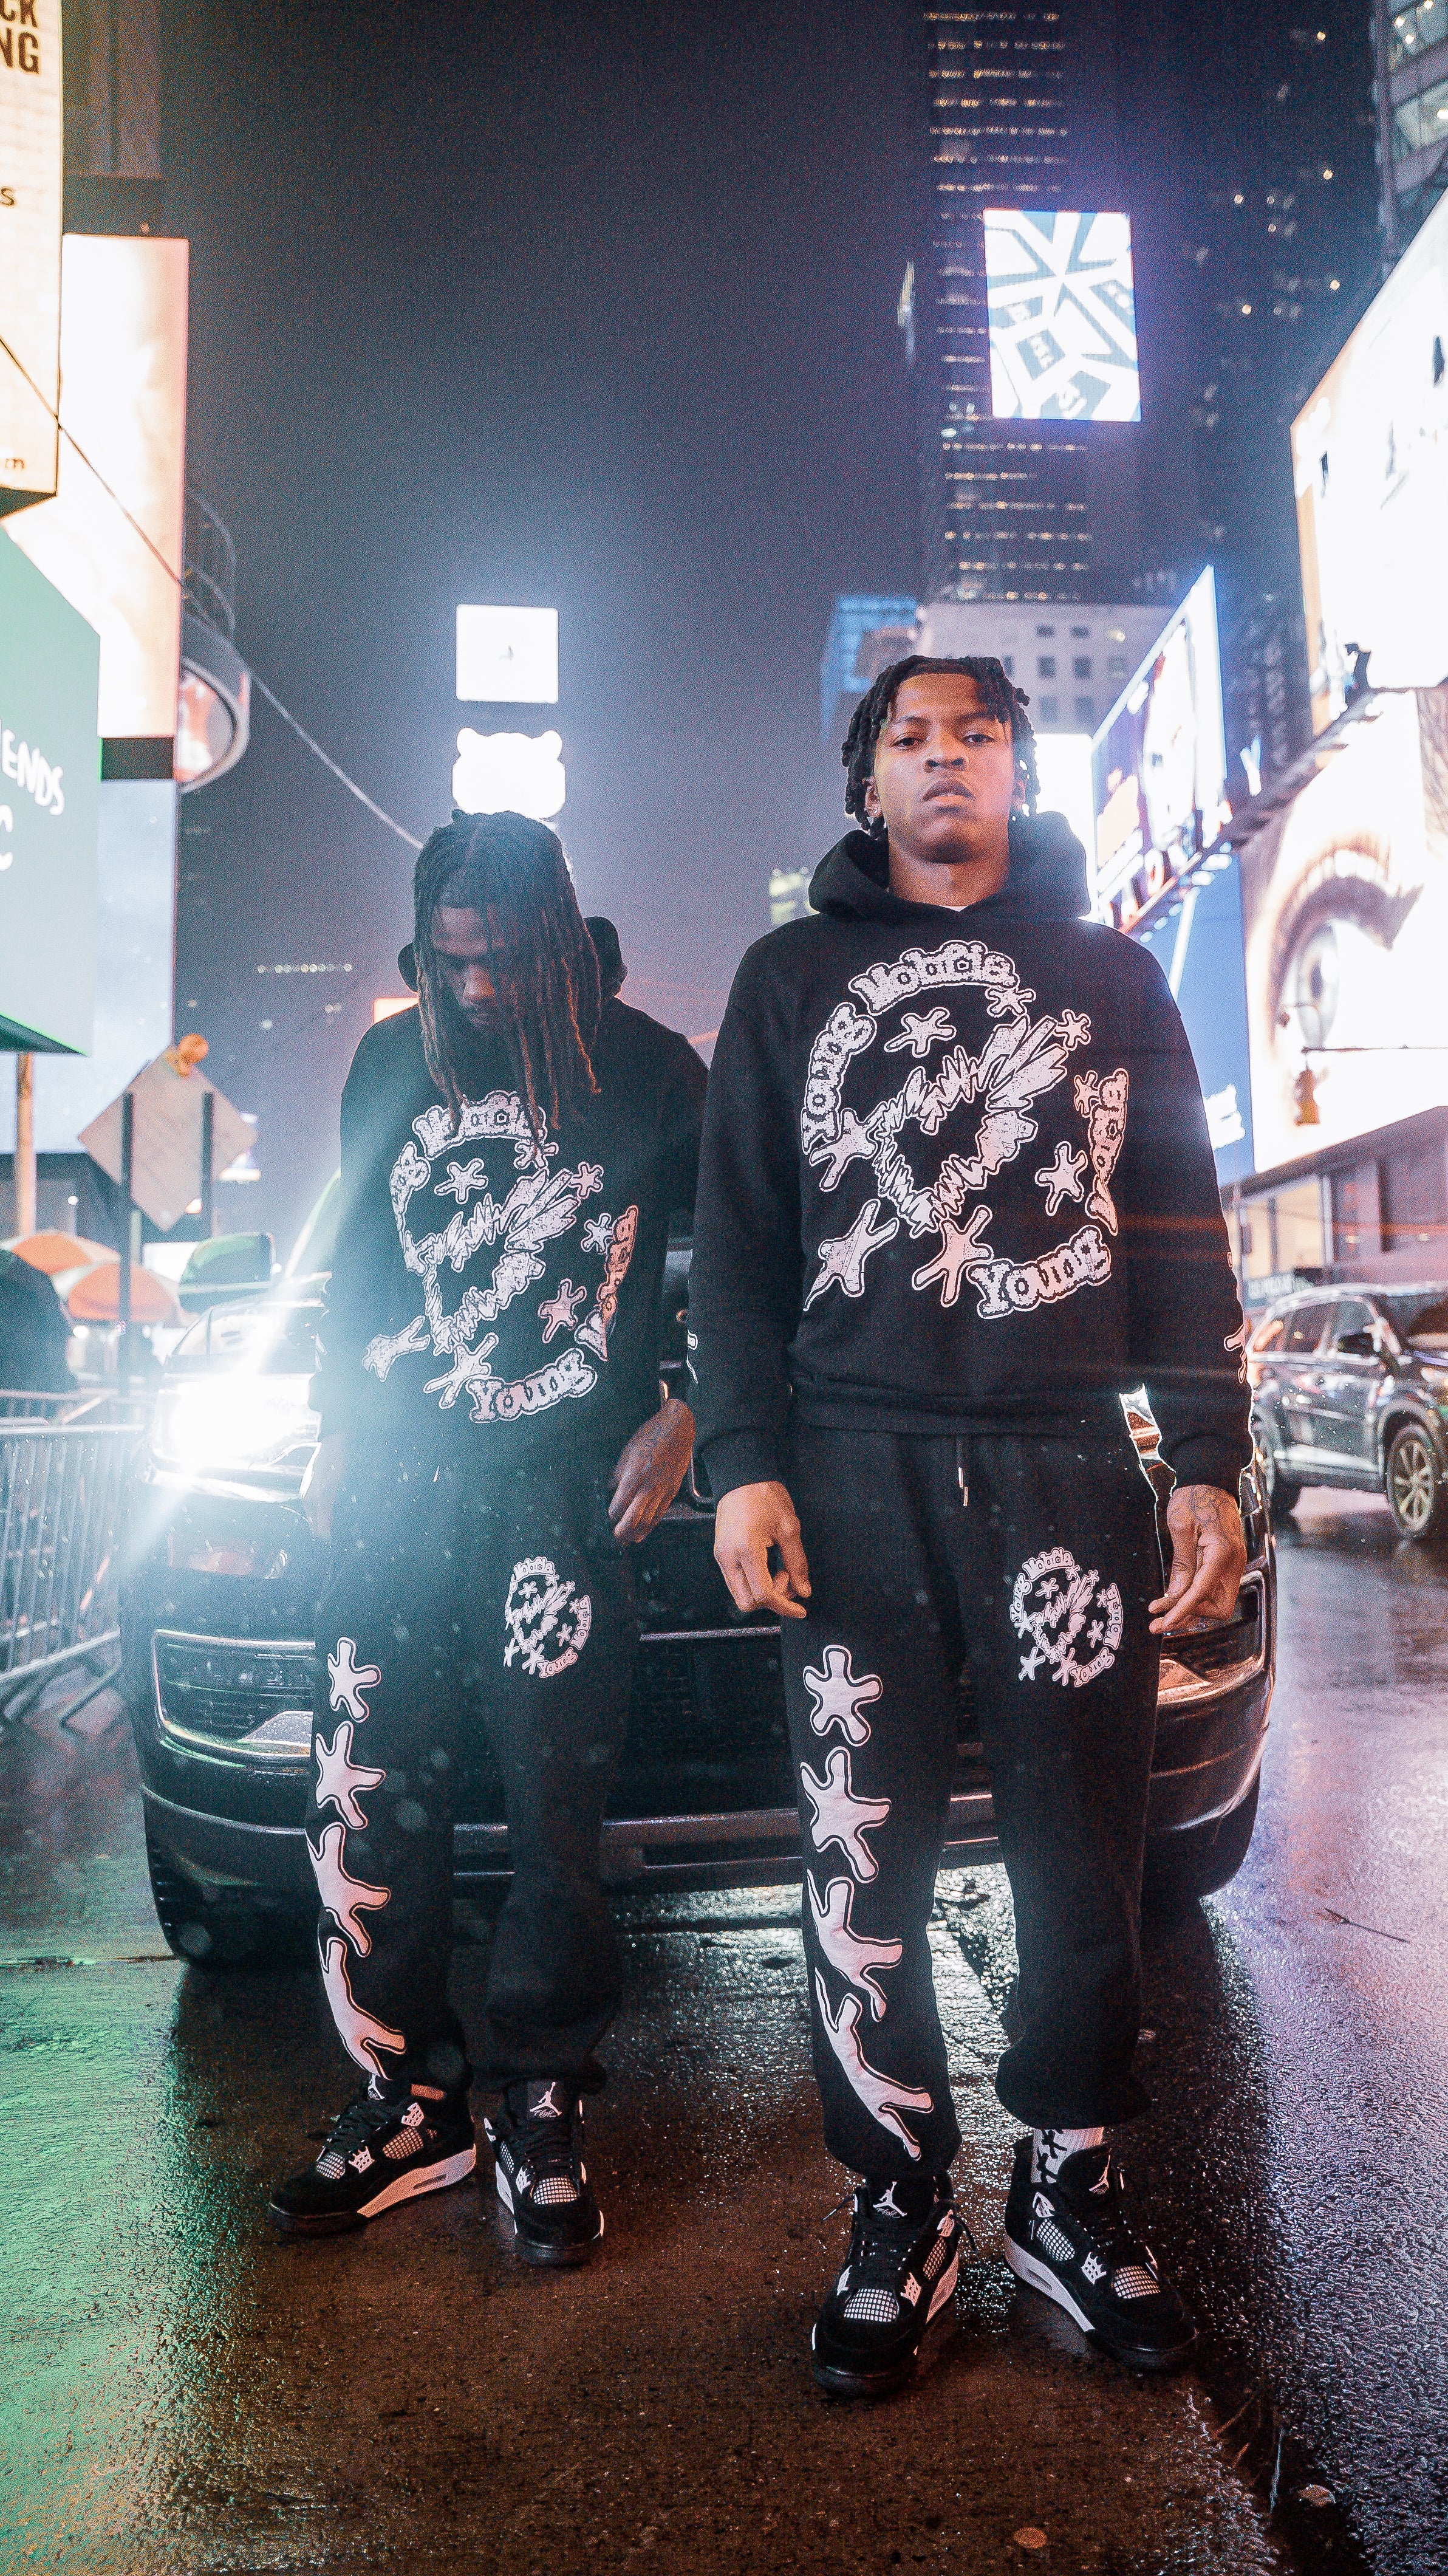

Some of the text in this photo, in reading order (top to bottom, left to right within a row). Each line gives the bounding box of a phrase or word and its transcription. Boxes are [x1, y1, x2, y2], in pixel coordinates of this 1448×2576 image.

[0, 719, 65, 815] ENDS
[968, 1225, 1111, 1318] Young
[465, 1347, 597, 1423] Young
[536, 1646, 578, 1679] Young
[1070, 1646, 1115, 1688] Young
